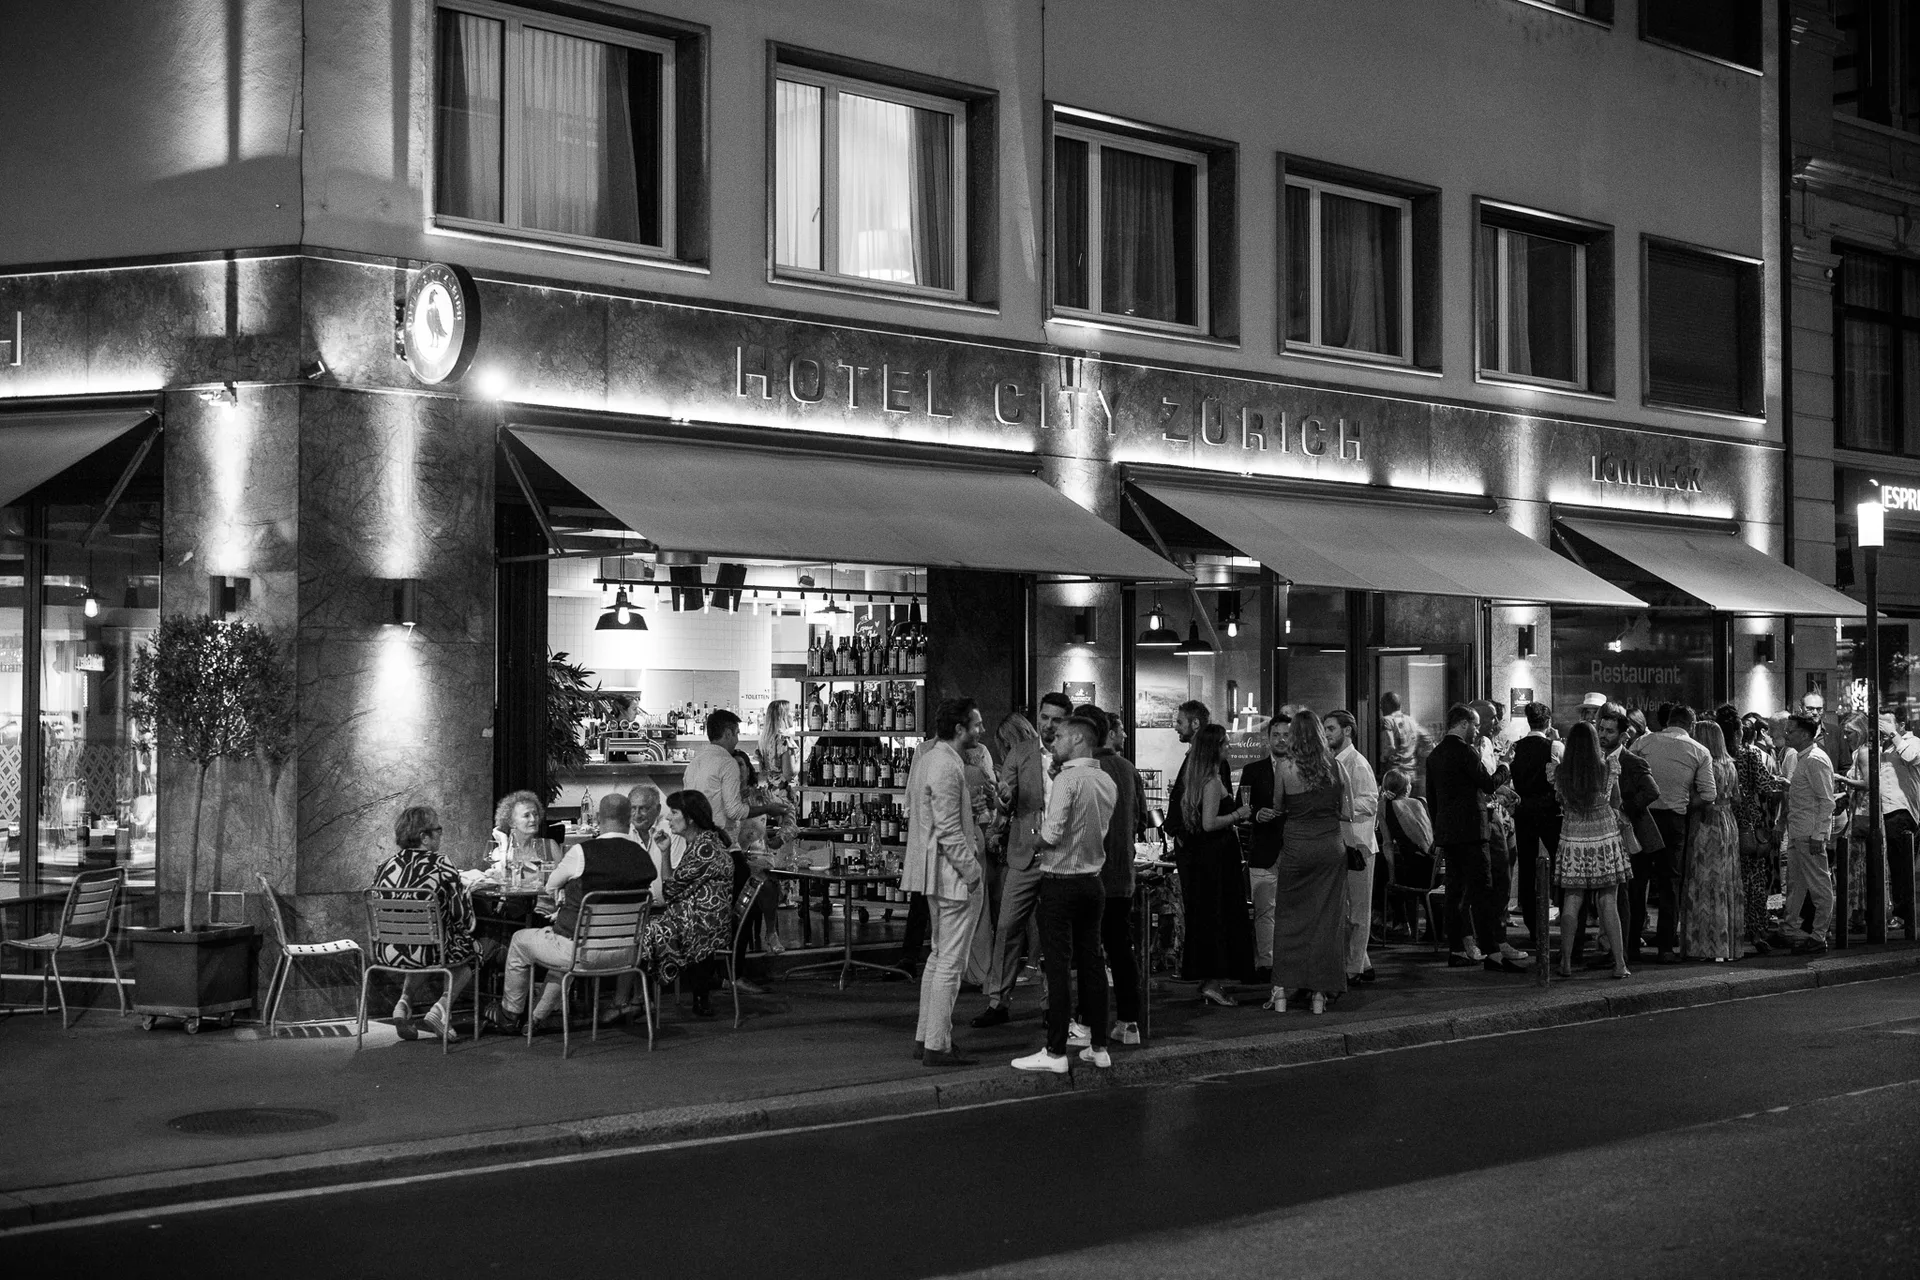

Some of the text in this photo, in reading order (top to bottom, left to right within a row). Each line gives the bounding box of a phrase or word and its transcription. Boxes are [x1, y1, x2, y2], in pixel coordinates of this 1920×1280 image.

[736, 345, 1364, 462] HOTEL CITY ZÜRICH
[1591, 451, 1702, 493] LÖWENECK
[1591, 659, 1681, 684] Restaurant
